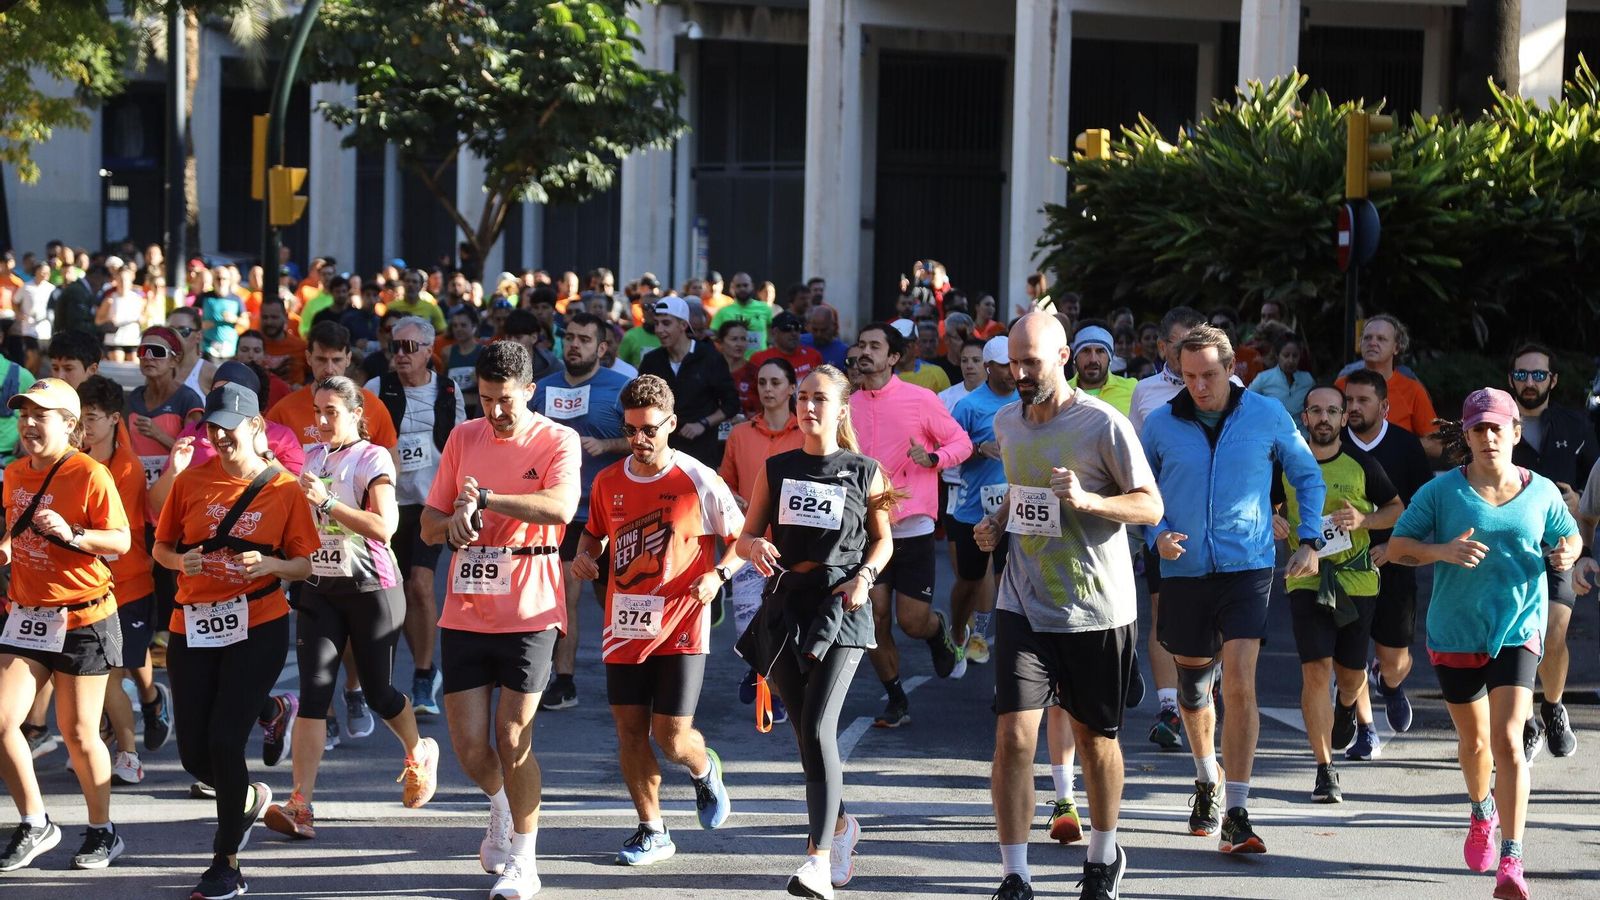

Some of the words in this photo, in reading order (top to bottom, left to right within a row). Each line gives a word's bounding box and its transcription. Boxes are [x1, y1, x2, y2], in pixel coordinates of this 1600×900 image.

[554, 397, 582, 410] 632
[398, 447, 423, 461] 24
[789, 495, 832, 515] 624
[1016, 502, 1049, 521] 465
[615, 529, 638, 552] LYING
[312, 550, 341, 564] 244
[460, 563, 499, 579] 869
[196, 614, 239, 635] 309
[618, 610, 652, 626] 374
[19, 619, 47, 637] 99
